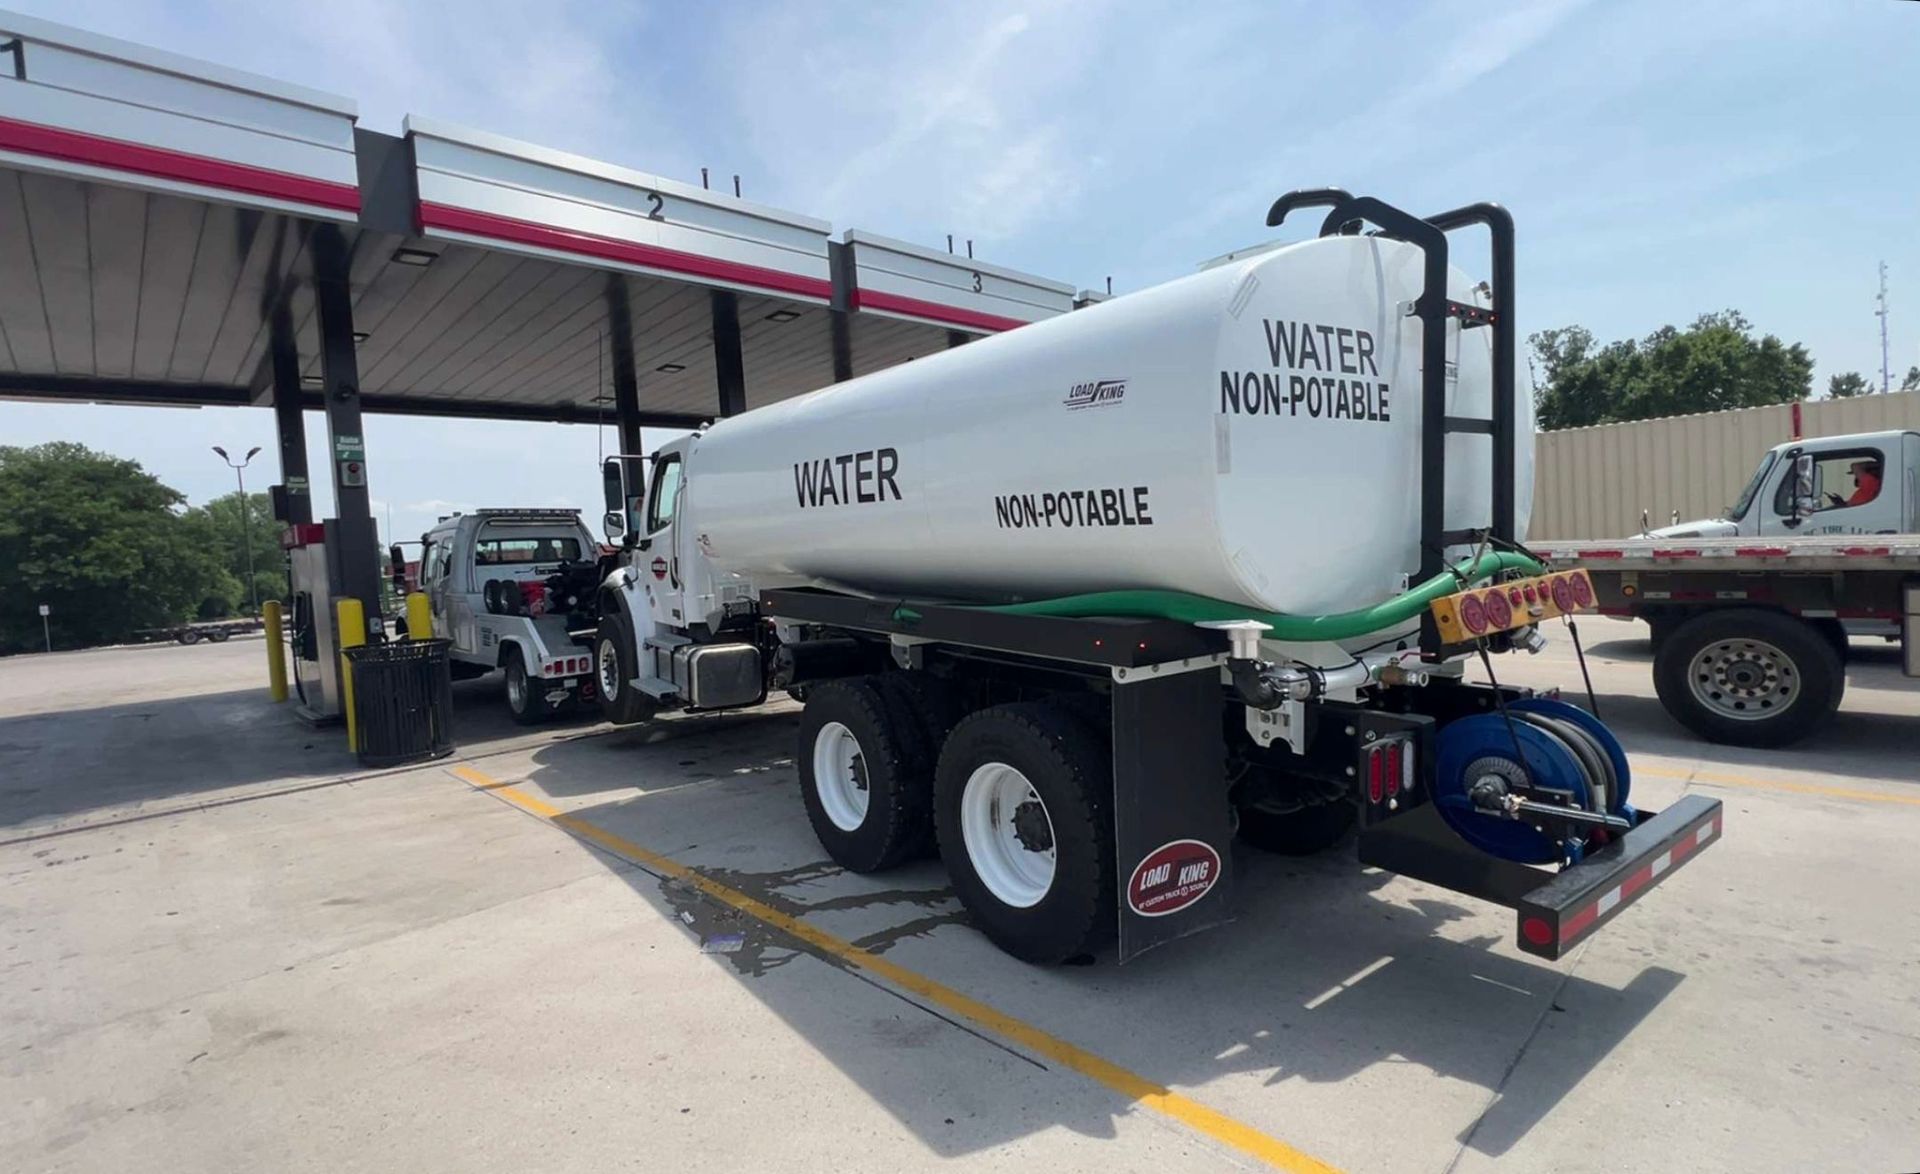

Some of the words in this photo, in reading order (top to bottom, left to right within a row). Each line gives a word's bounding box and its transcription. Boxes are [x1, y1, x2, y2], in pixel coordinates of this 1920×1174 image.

[647, 192, 665, 222] 2
[972, 272, 983, 294] 3
[1263, 318, 1379, 377] WATER
[1069, 381, 1095, 399] LOAD
[1098, 384, 1125, 401] KING
[1220, 371, 1391, 422] NON-POTABLE
[794, 447, 902, 508] WATER
[995, 486, 1154, 528] NON-POTABLE
[1140, 862, 1171, 892] LOAD
[1178, 861, 1210, 887] KING
[1165, 888, 1181, 900] TRUCK
